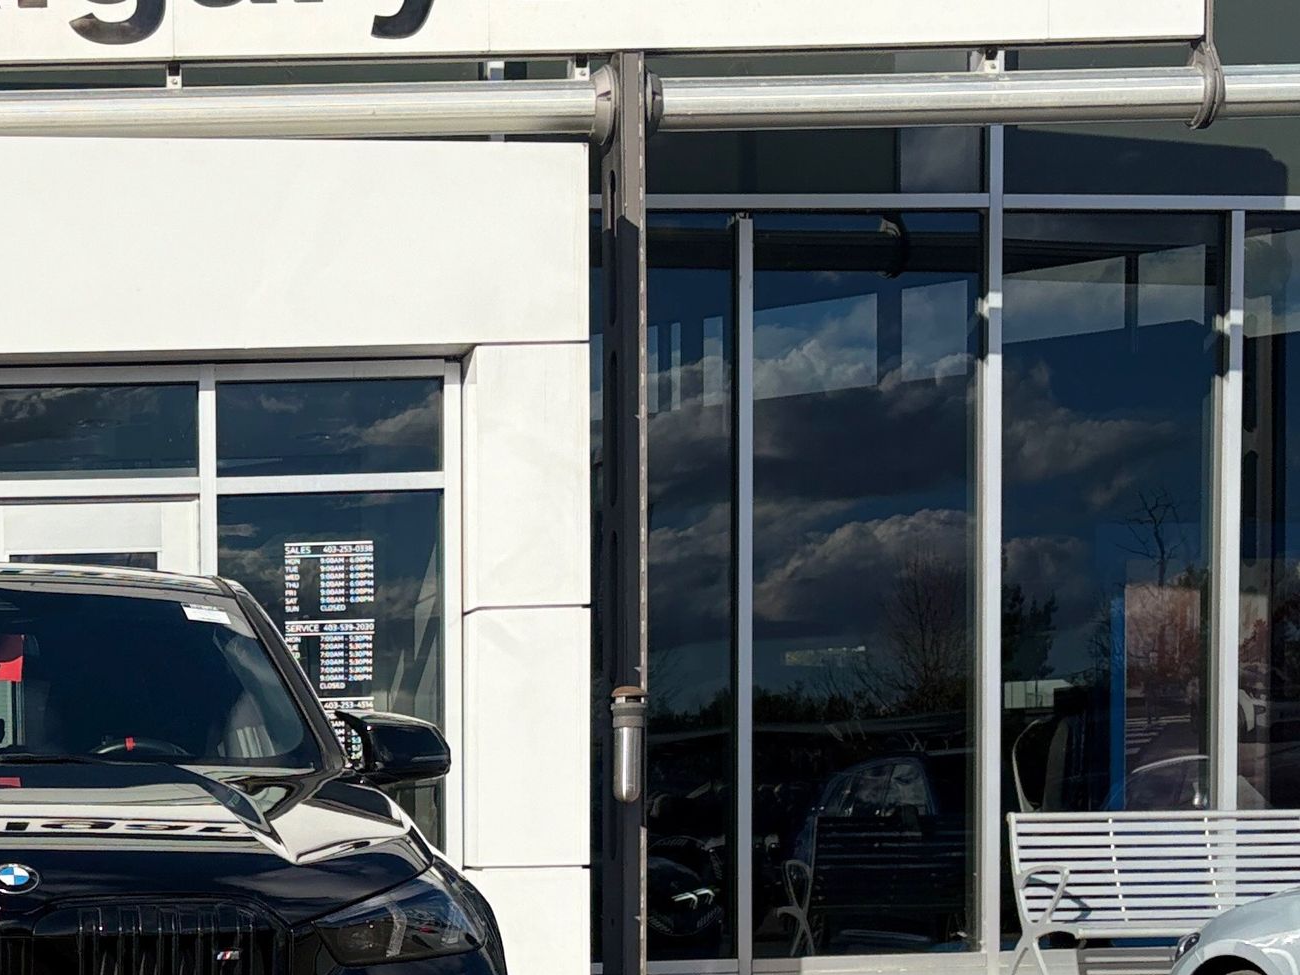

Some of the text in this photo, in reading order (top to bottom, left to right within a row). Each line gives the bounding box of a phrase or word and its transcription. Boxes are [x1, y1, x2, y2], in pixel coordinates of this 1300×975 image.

[285, 545, 373, 555] SALES 403-253-0338
[320, 604, 346, 612] CLOSED
[285, 624, 319, 632] SERVICE
[320, 682, 346, 690] CLOSED
